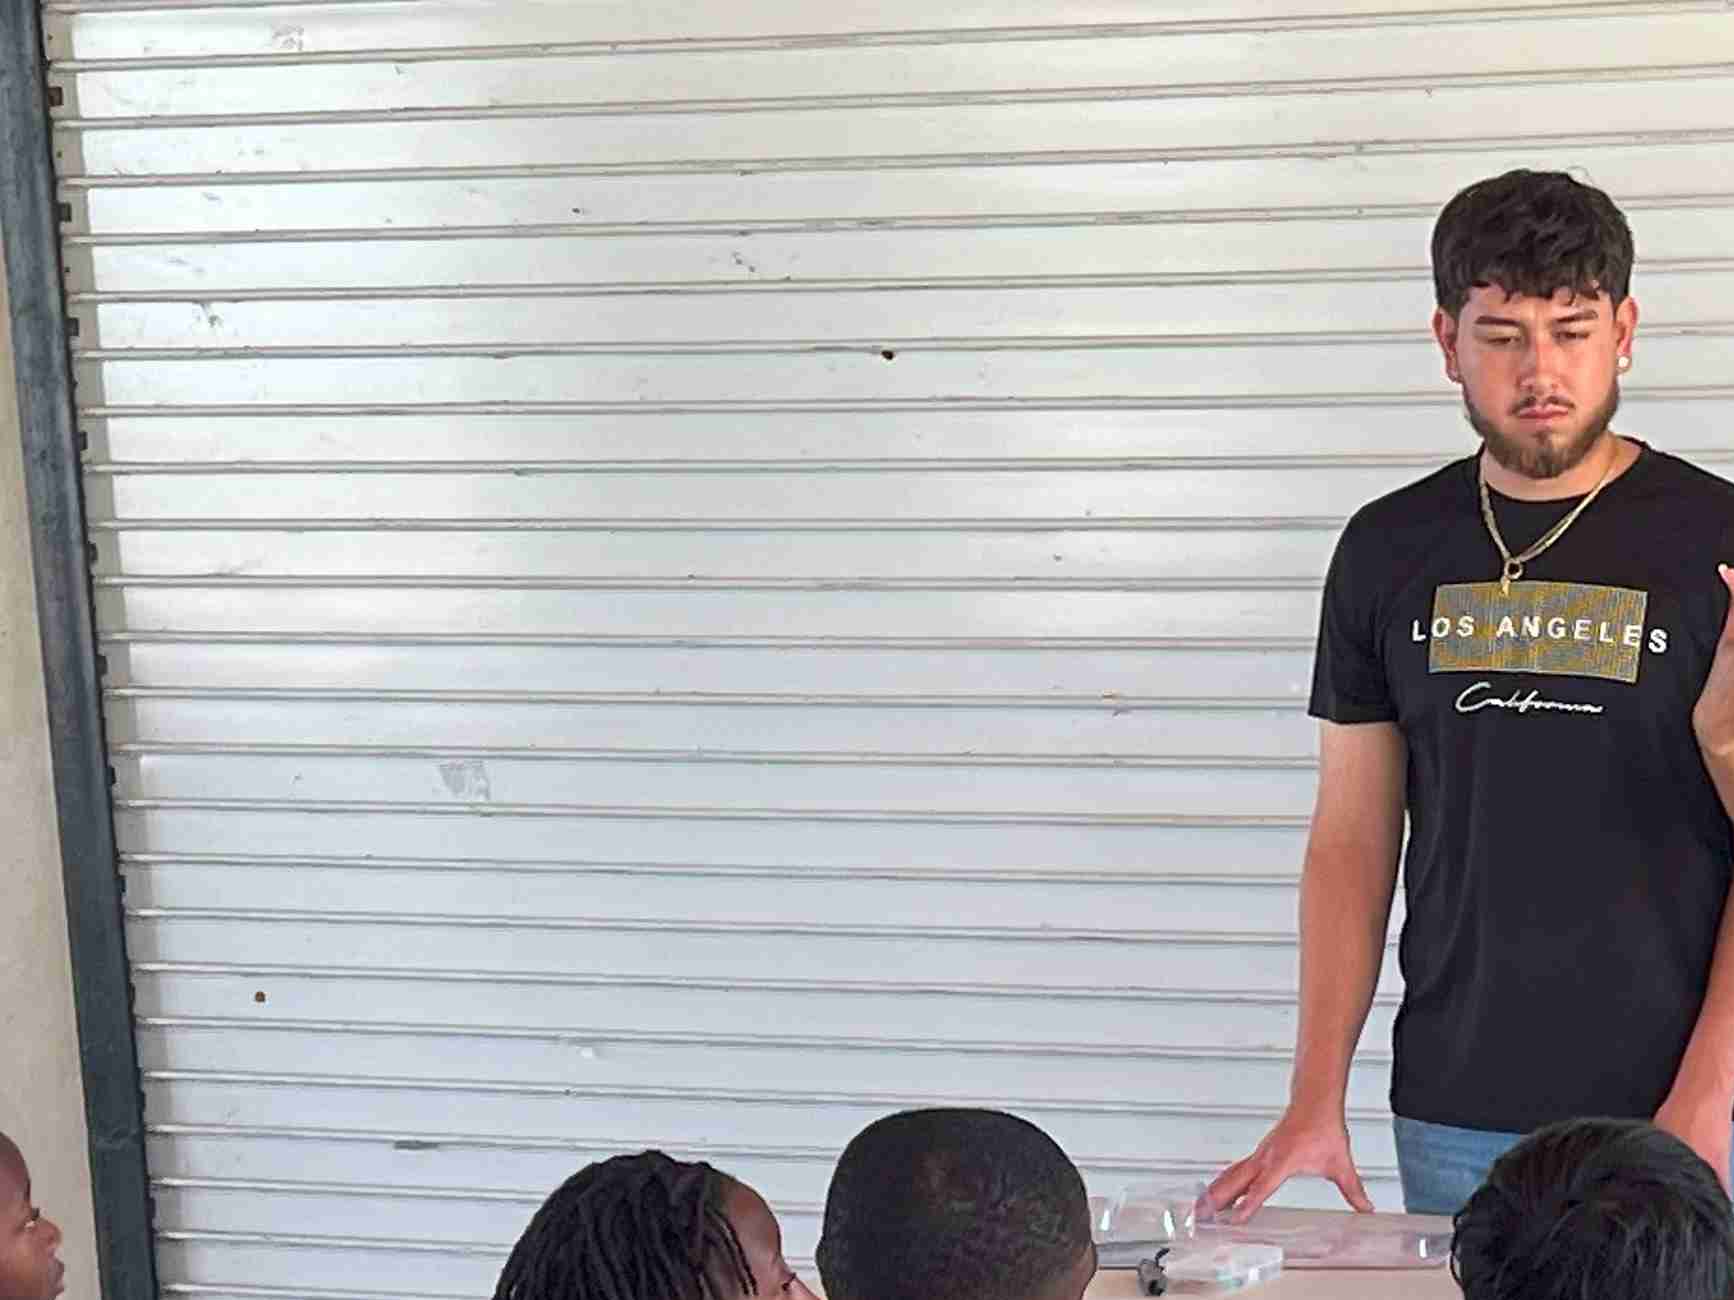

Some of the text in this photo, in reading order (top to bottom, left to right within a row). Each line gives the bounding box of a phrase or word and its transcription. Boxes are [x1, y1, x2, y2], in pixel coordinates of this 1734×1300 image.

[1411, 615, 1668, 654] LOS ANGELES
[1455, 681, 1603, 713] California
